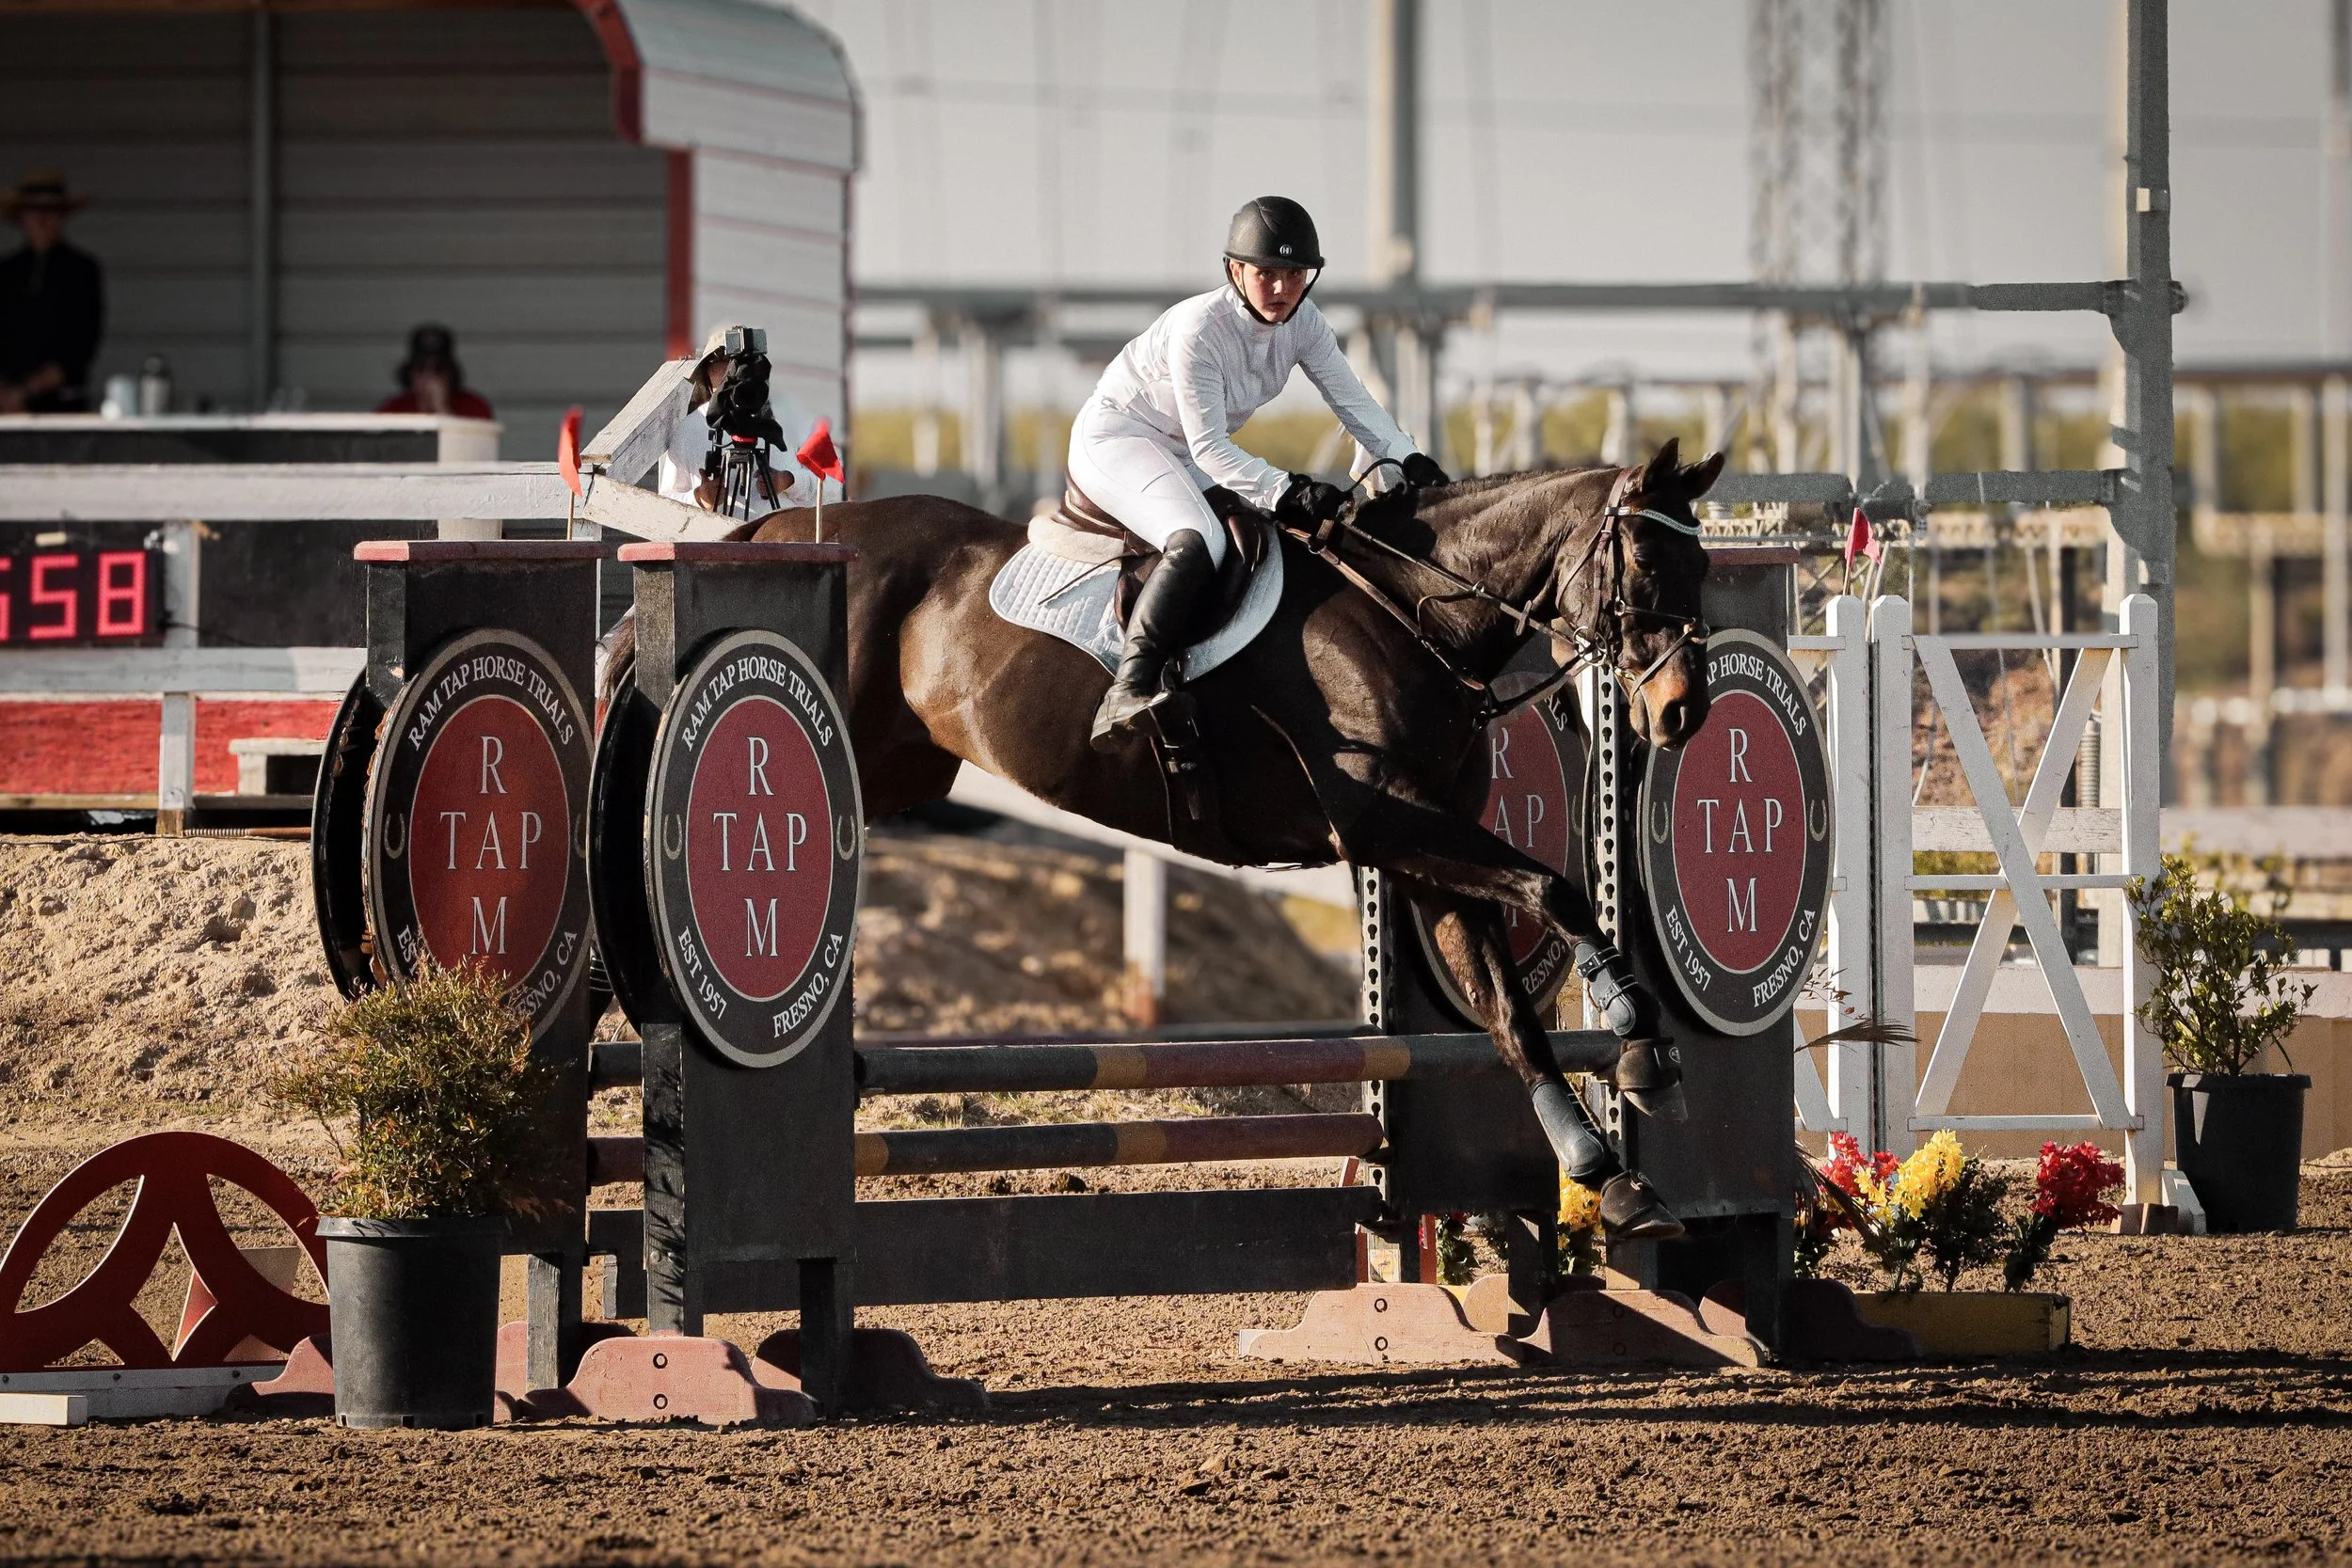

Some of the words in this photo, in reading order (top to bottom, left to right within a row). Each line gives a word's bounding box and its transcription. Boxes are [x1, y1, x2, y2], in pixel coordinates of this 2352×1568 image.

[0, 550, 146, 641] 58
[408, 689, 443, 751] RAM
[440, 664, 469, 701] TAP
[472, 656, 526, 686] HORSE
[528, 669, 574, 745] TRIALS
[681, 689, 712, 752] RAM
[709, 664, 736, 701] TAP
[738, 656, 787, 686] HORSE
[787, 670, 834, 747] TRIALS
[1719, 653, 1764, 681] HORSE
[1766, 666, 1806, 736] TRIALS
[480, 736, 508, 794] R
[746, 736, 774, 796] R
[1491, 727, 1514, 779] R
[1728, 728, 1753, 783] R
[439, 811, 542, 869] TAP
[712, 813, 807, 871] TAP
[1494, 794, 1544, 847] AP
[1697, 798, 1783, 853] TAP
[470, 896, 508, 955] M
[744, 898, 779, 957] M
[1726, 878, 1757, 932] M
[557, 931, 578, 965] CA
[678, 926, 702, 978] EST
[698, 974, 727, 1020] 1957
[1522, 941, 1566, 994] RESNO,
[1665, 905, 1689, 954] EST
[1685, 950, 1711, 991] 1957
[1752, 945, 1804, 1007] FRESNO,
[1798, 910, 1816, 942] CA
[772, 973, 830, 1038] FRESNO,
[824, 933, 843, 969] CA
